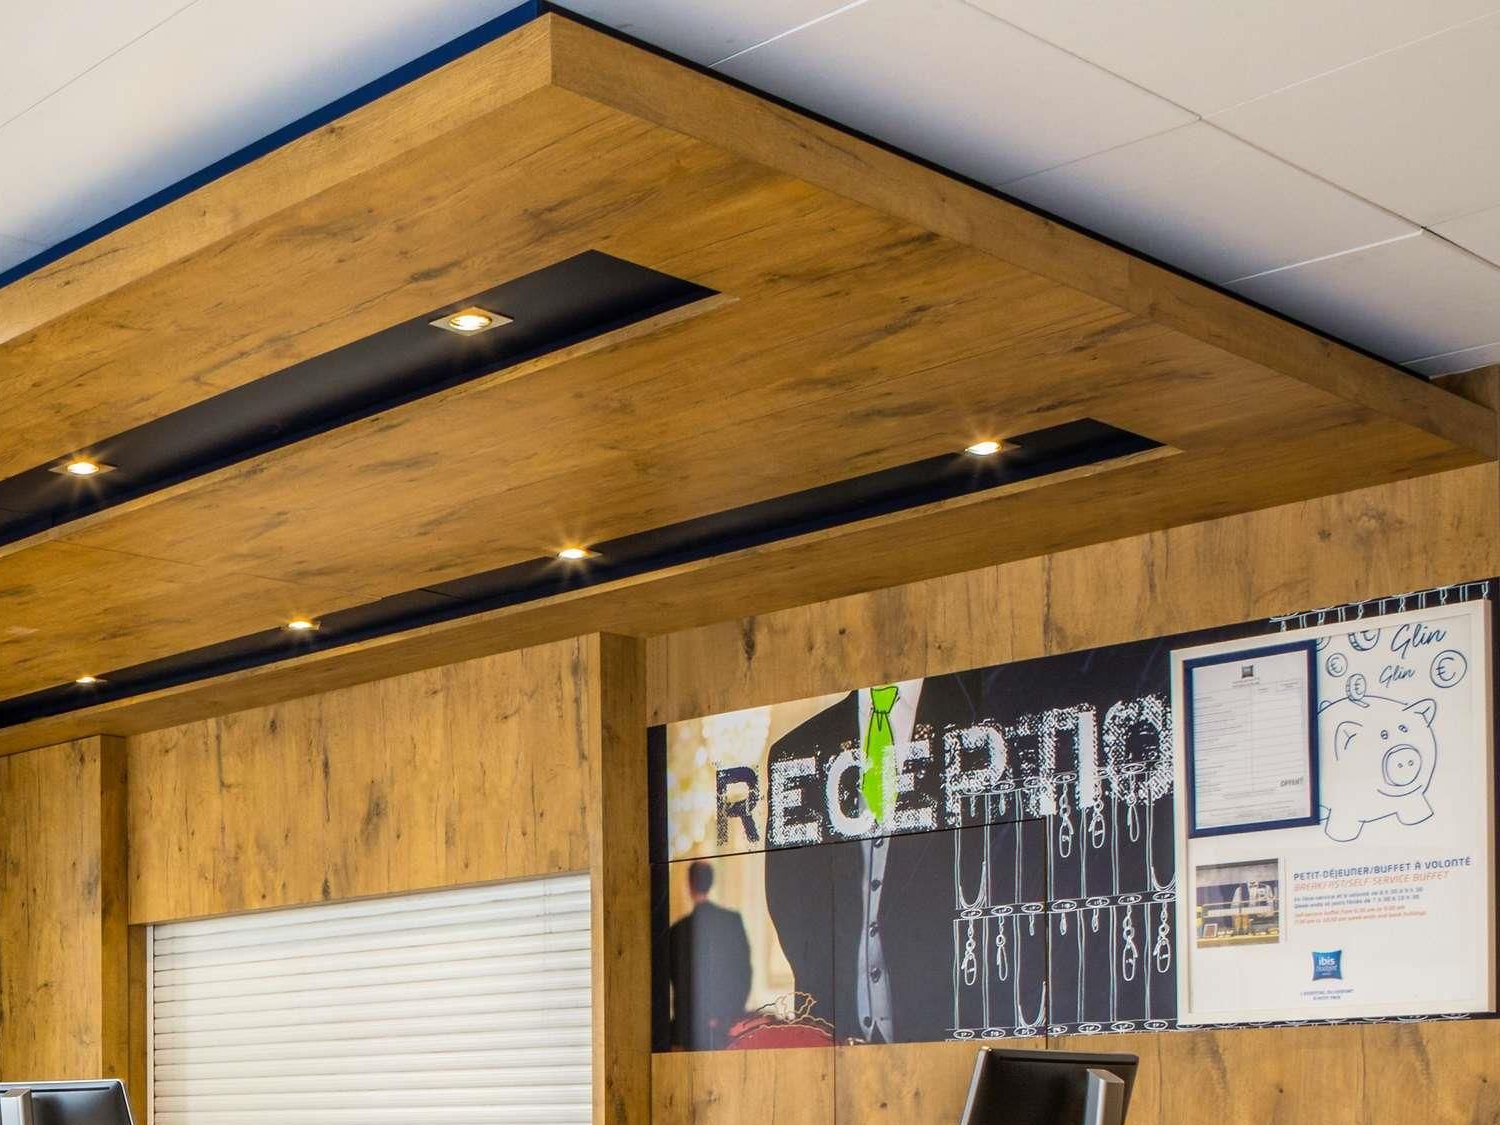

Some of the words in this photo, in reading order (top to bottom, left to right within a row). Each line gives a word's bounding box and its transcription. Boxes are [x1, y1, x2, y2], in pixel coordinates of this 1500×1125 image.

[1390, 623, 1447, 660] Glin
[1379, 665, 1415, 688] Glin
[1424, 855, 1471, 870] VOLONTÉ
